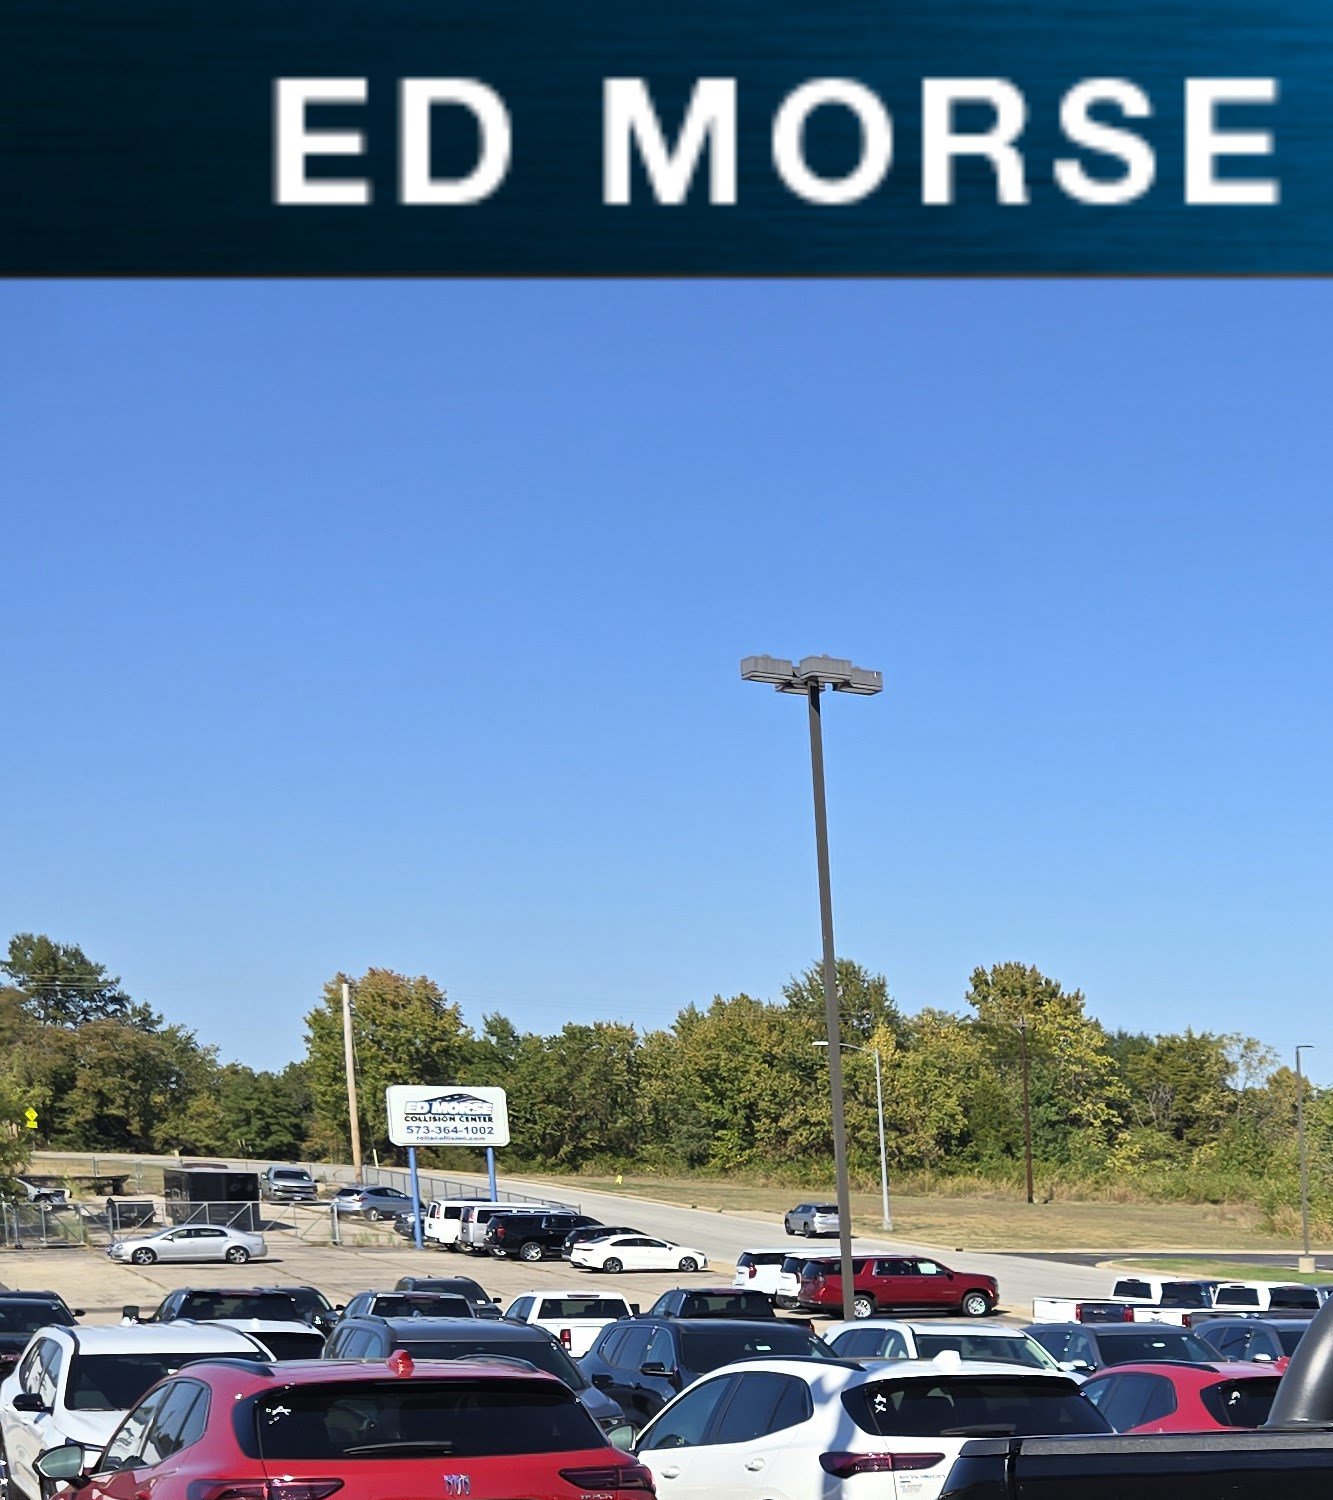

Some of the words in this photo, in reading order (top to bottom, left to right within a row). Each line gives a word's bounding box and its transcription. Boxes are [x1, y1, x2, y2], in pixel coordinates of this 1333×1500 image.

[404, 1115, 456, 1123] COLLISION
[459, 1115, 494, 1123] CENTER
[406, 1125, 495, 1135] 573-364-1002
